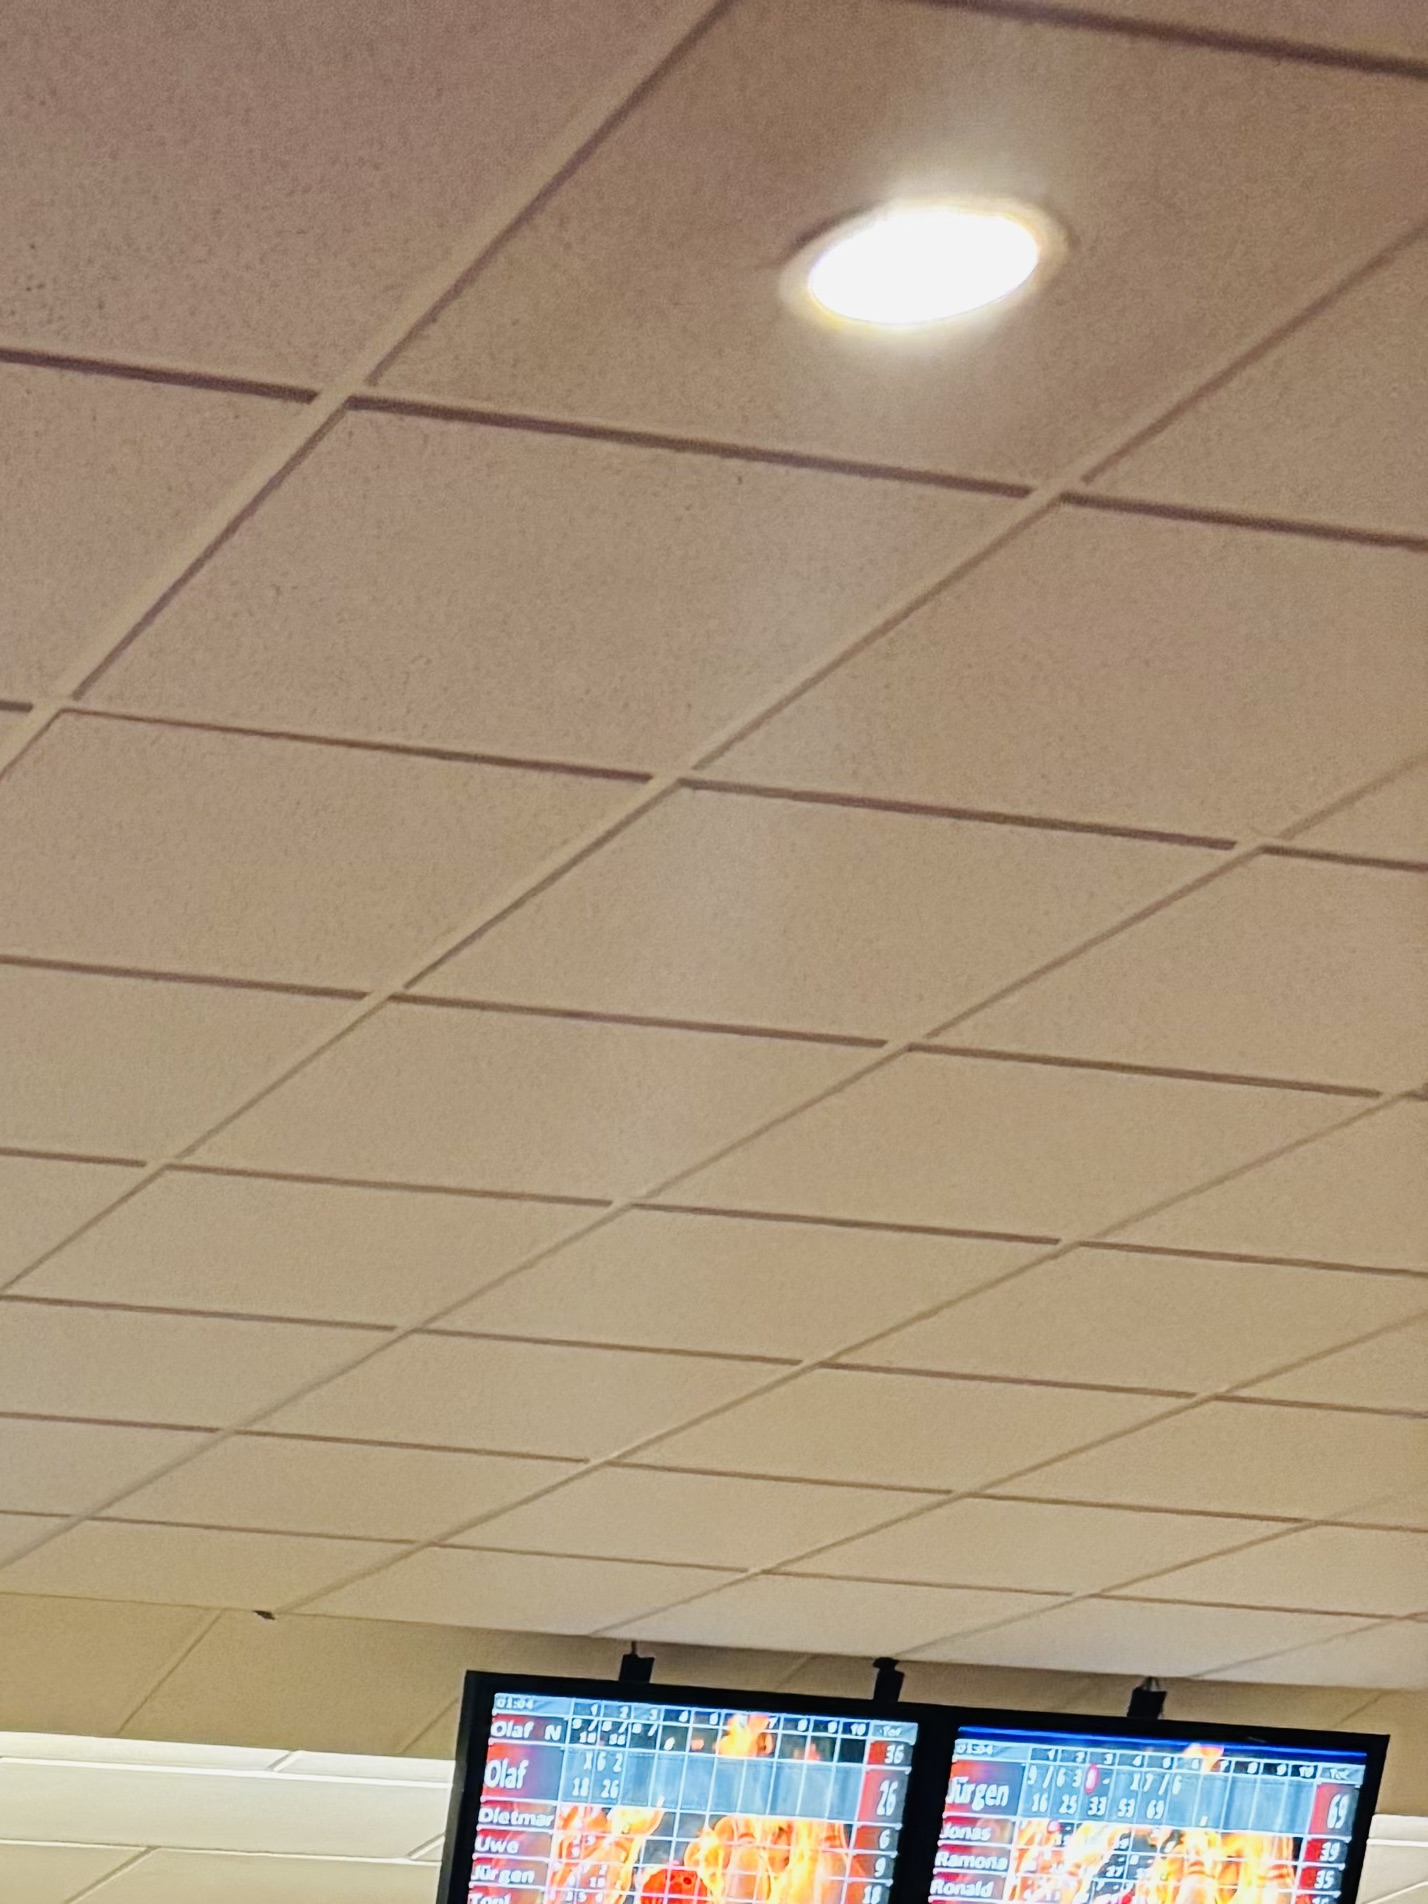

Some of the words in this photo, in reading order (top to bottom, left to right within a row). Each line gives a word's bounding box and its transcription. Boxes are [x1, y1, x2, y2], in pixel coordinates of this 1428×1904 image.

[491, 1720, 535, 1739] Olaf
[545, 1724, 562, 1741] N
[485, 1759, 528, 1789] Olaf
[948, 1776, 1009, 1811] Jürgen
[479, 1808, 554, 1827] Dietmar
[940, 1823, 991, 1841] Jonas
[475, 1836, 519, 1854] Uwe
[935, 1851, 1007, 1871] Ramona
[471, 1864, 535, 1886] Jürgen
[930, 1879, 993, 1897] Ronald
